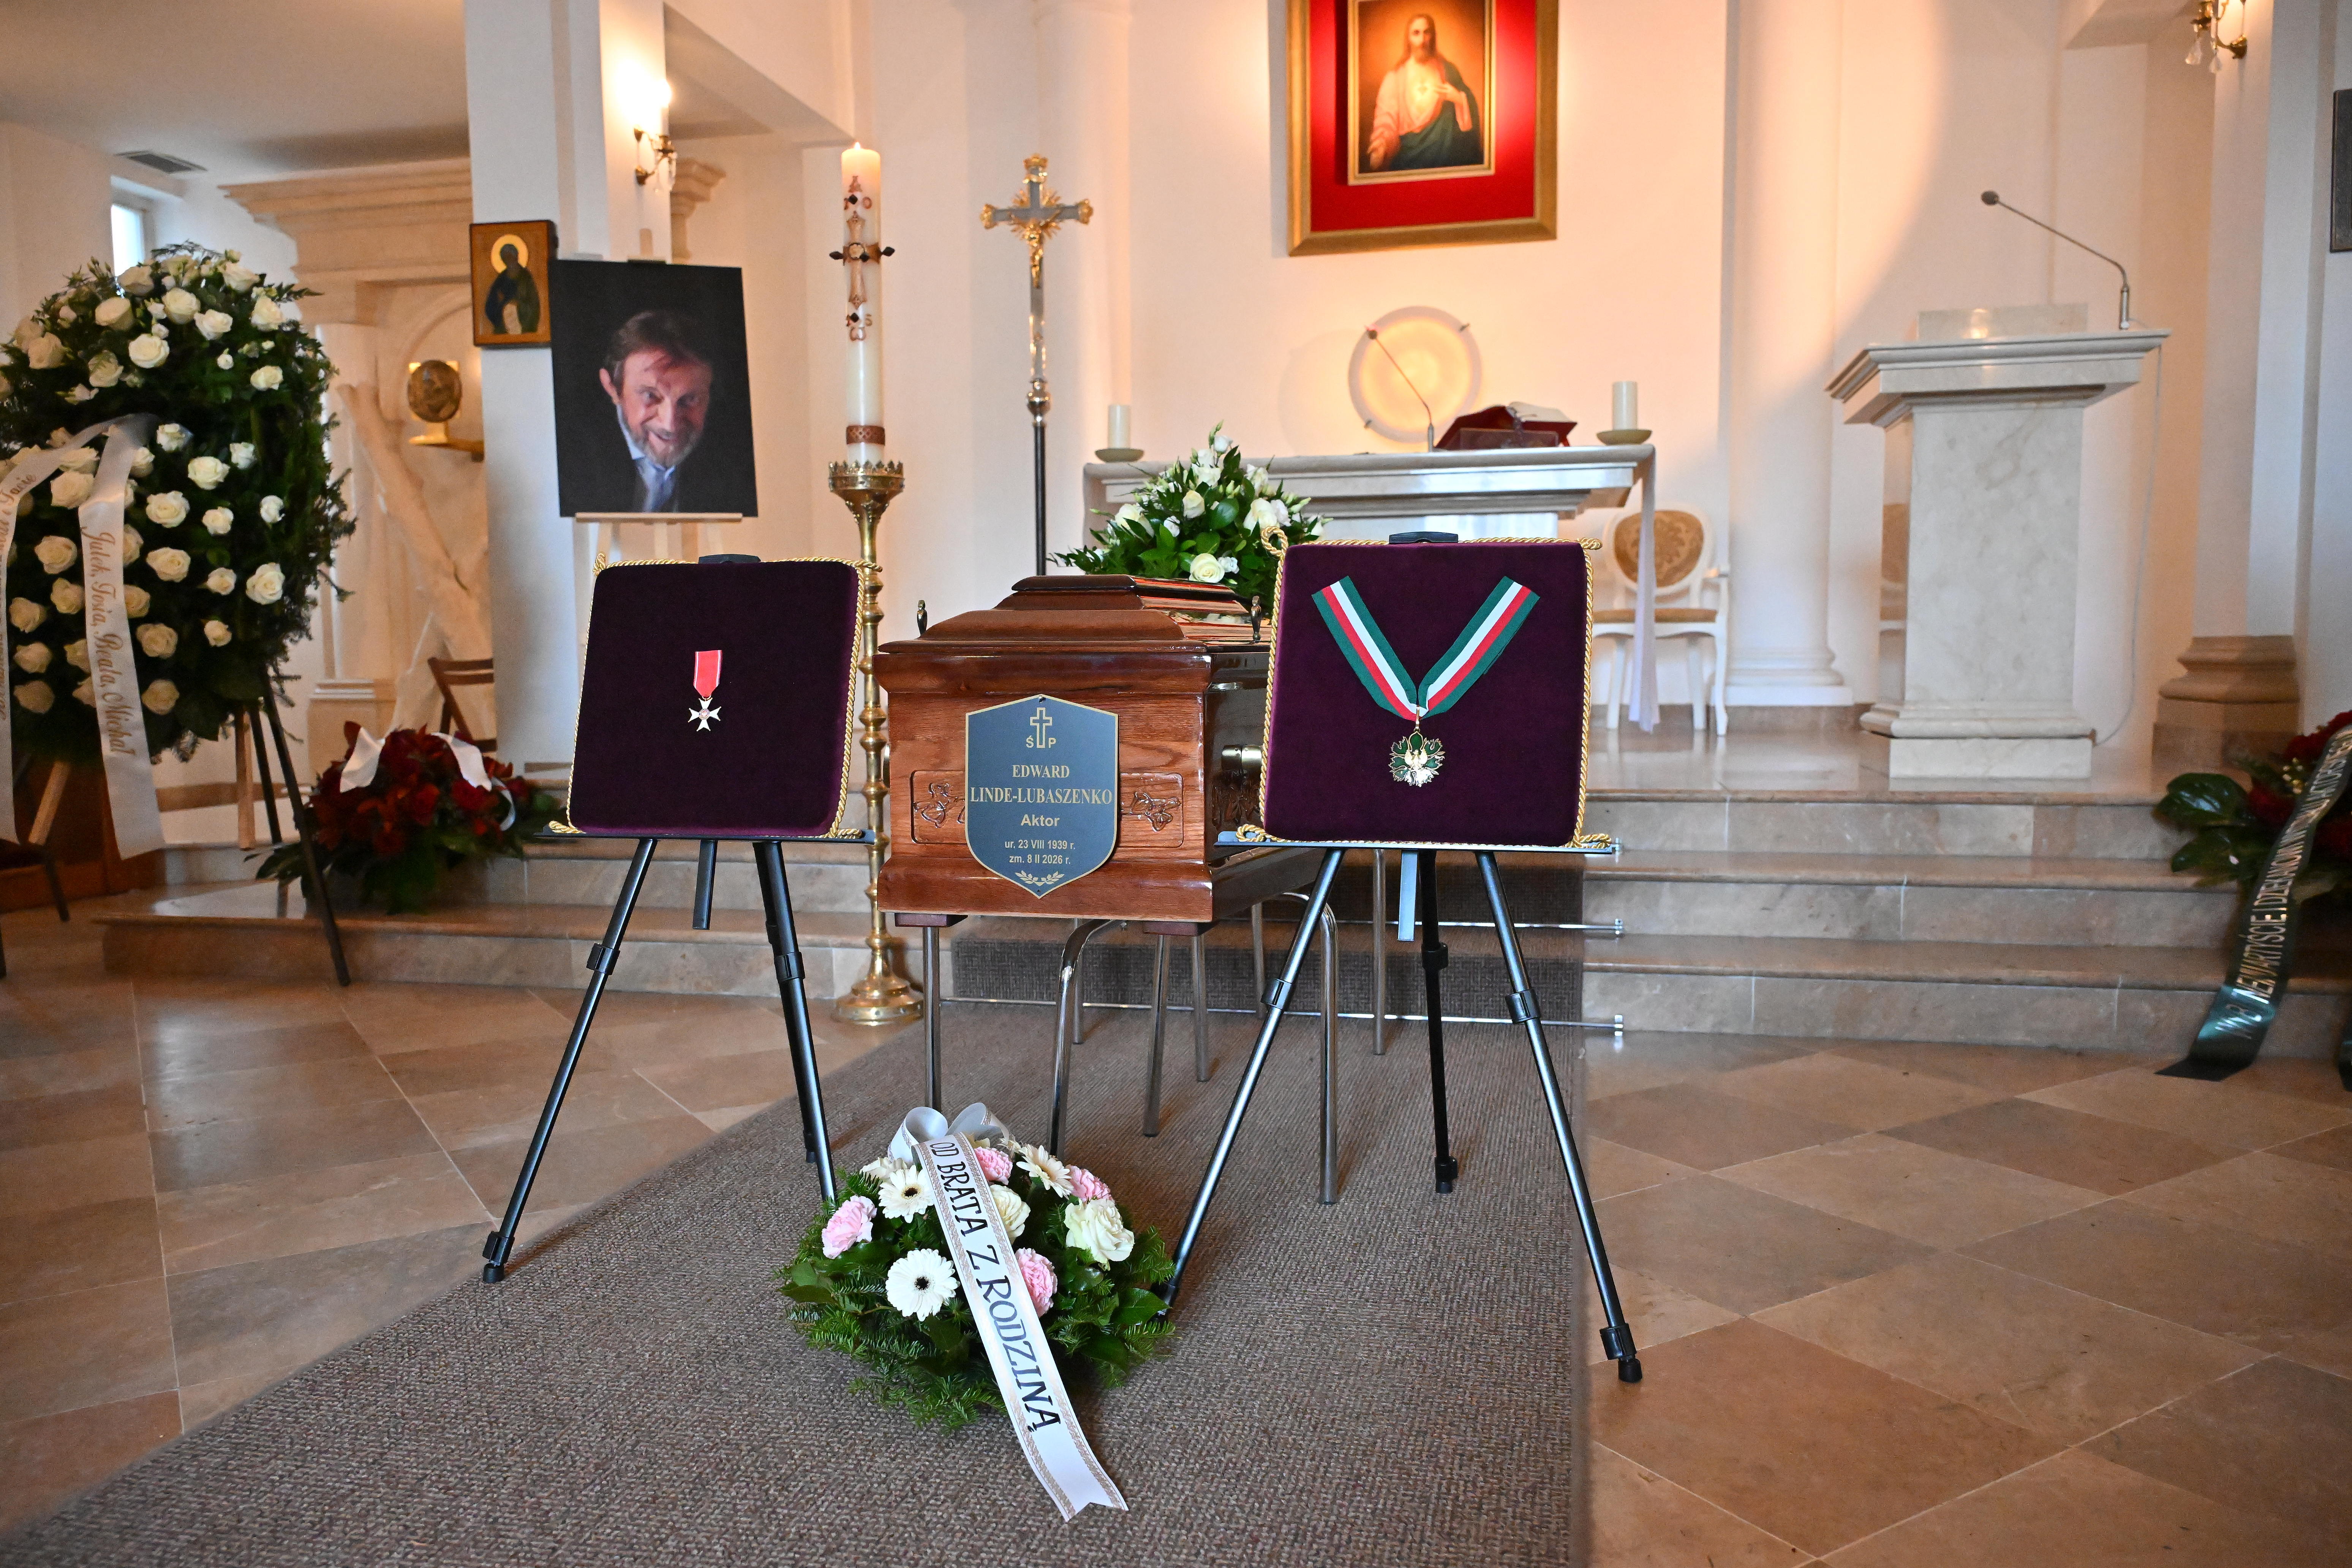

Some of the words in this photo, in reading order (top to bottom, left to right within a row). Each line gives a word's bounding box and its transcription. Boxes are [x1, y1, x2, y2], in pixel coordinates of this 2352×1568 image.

[1048, 738, 1056, 748] P
[1012, 765, 1070, 778] EDWARD
[970, 787, 1113, 805] LINDE-LUBASZENKO
[1021, 814, 1060, 827] Aktor
[1018, 839, 1028, 849] 23
[1031, 839, 1045, 849] VIII
[1048, 840, 1067, 850] 1939
[1027, 854, 1032, 863] 8
[1035, 854, 1040, 863] II
[1042, 855, 1063, 864] 2026
[930, 1142, 959, 1157] OD
[937, 1161, 988, 1237] BRATA
[966, 1244, 1000, 1270] Z
